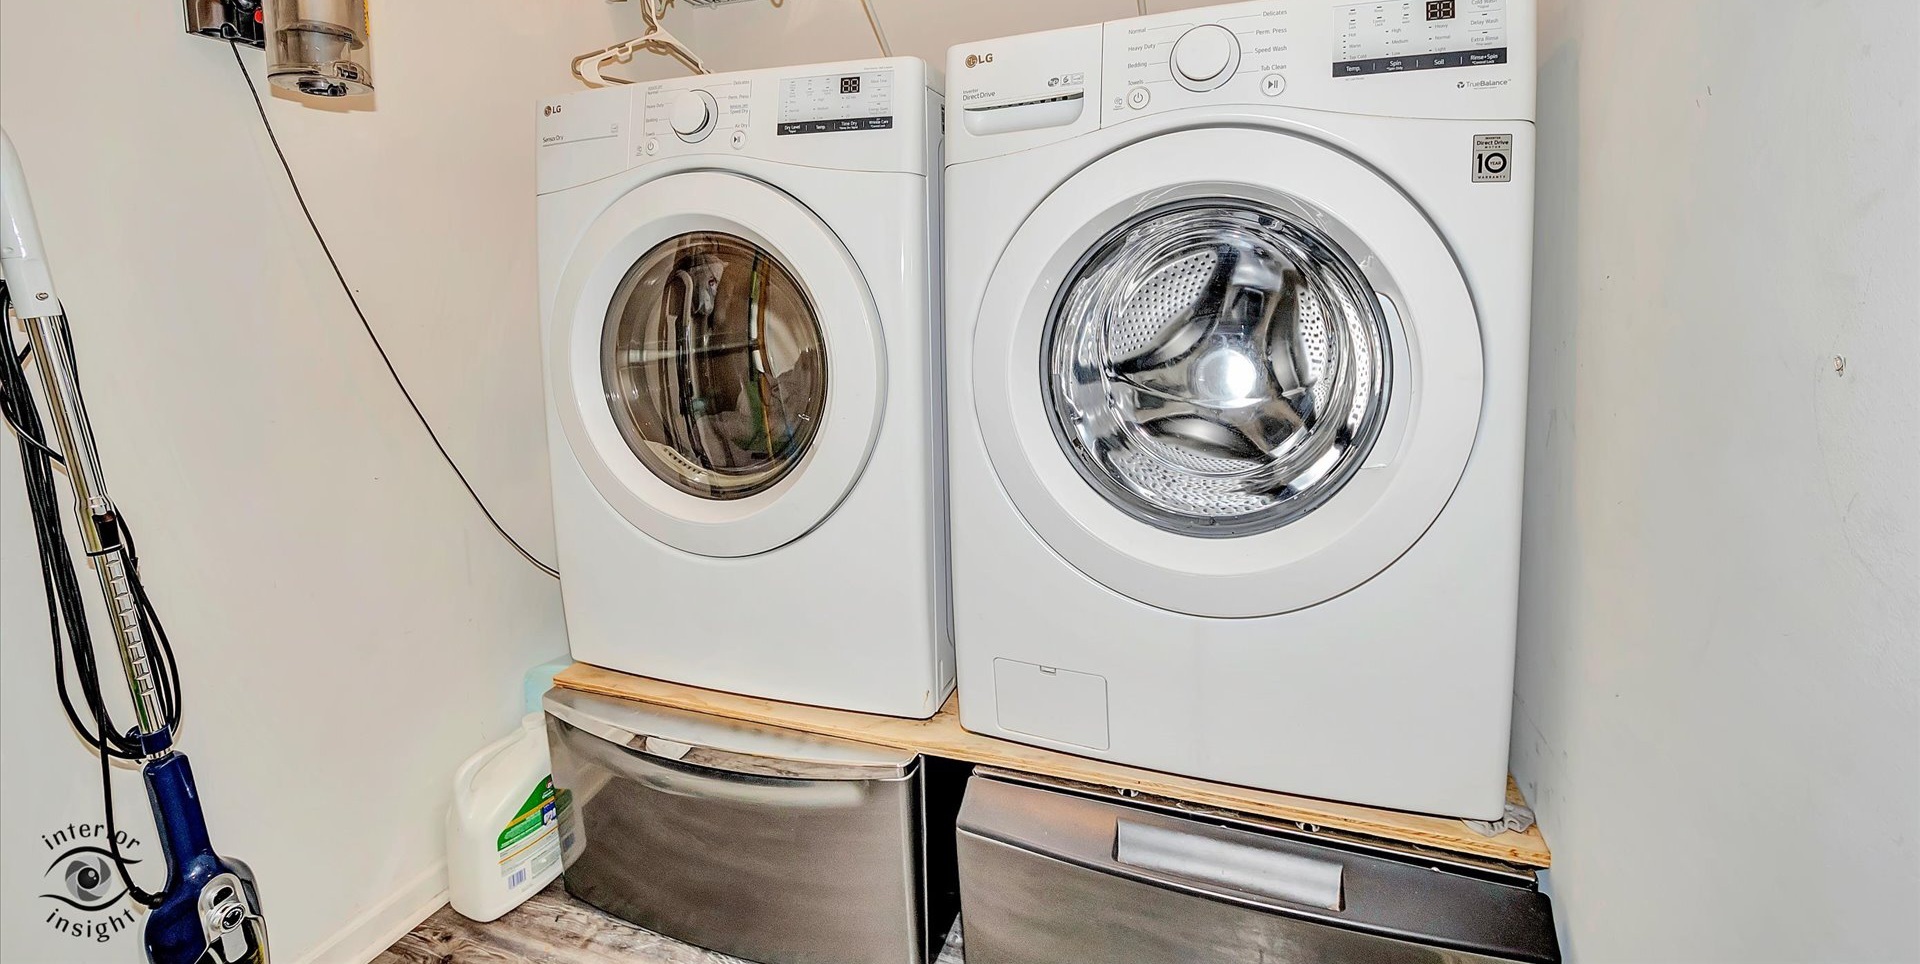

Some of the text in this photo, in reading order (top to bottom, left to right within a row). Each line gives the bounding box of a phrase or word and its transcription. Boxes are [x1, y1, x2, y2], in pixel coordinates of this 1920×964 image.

[1254, 47, 1271, 55] Speed
[1127, 61, 1147, 69] Bedding
[552, 105, 562, 114] LG
[1477, 152, 1507, 174] 10
